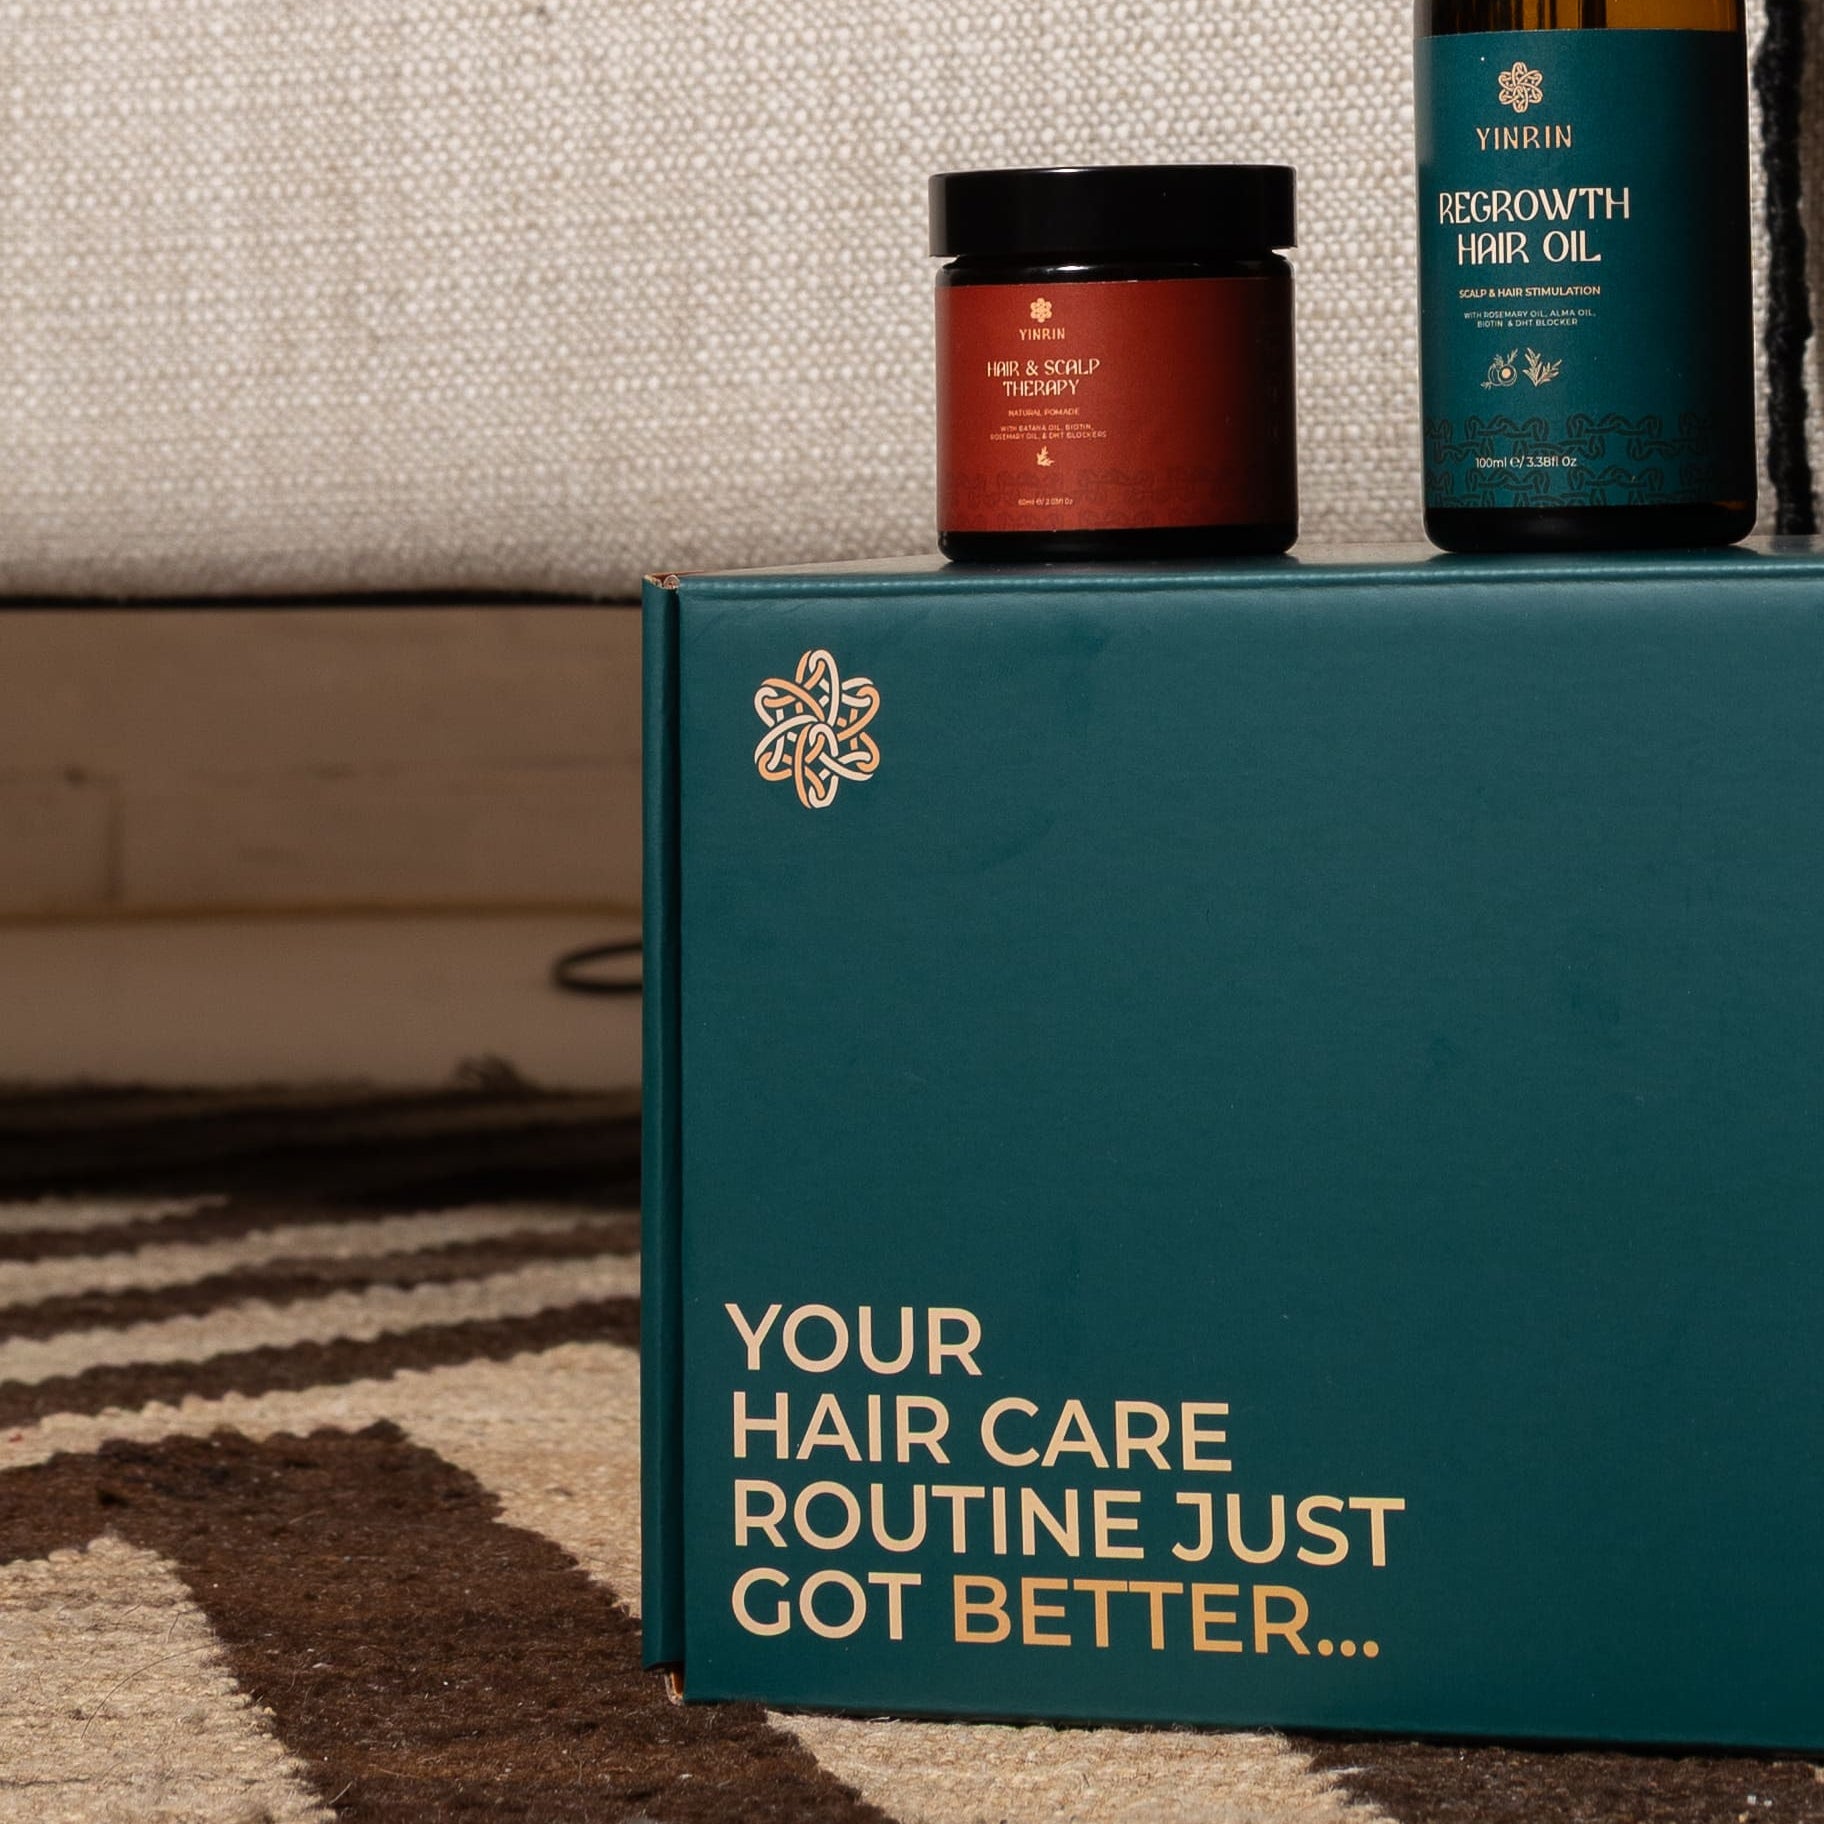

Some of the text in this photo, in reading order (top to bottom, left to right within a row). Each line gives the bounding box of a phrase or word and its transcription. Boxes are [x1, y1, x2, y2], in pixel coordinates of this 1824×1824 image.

[1476, 125, 1573, 151] YINRIN
[1439, 187, 1630, 224] REGROWTH
[1458, 229, 1601, 265] HAIR OIL
[1459, 286, 1600, 298] SCALP & HAIR STIMULATION
[1477, 320, 1502, 328] BIOTIN
[1515, 319, 1533, 327] DHT
[1536, 318, 1578, 327] BLOCKER
[1484, 310, 1528, 319] ROSEMARY
[1550, 309, 1575, 317] ALMA
[1019, 328, 1065, 340] YINRIN
[987, 358, 1100, 377] HAIR & SCALP
[1003, 379, 1080, 397] THERAPY
[1475, 457, 1507, 468] 100ml
[725, 1302, 983, 1376] YOUR
[732, 1391, 1233, 1472] HAIR CARE
[734, 1479, 1406, 1567] ROUTINE JUST
[731, 1567, 1380, 1658] GOT BETTER...
